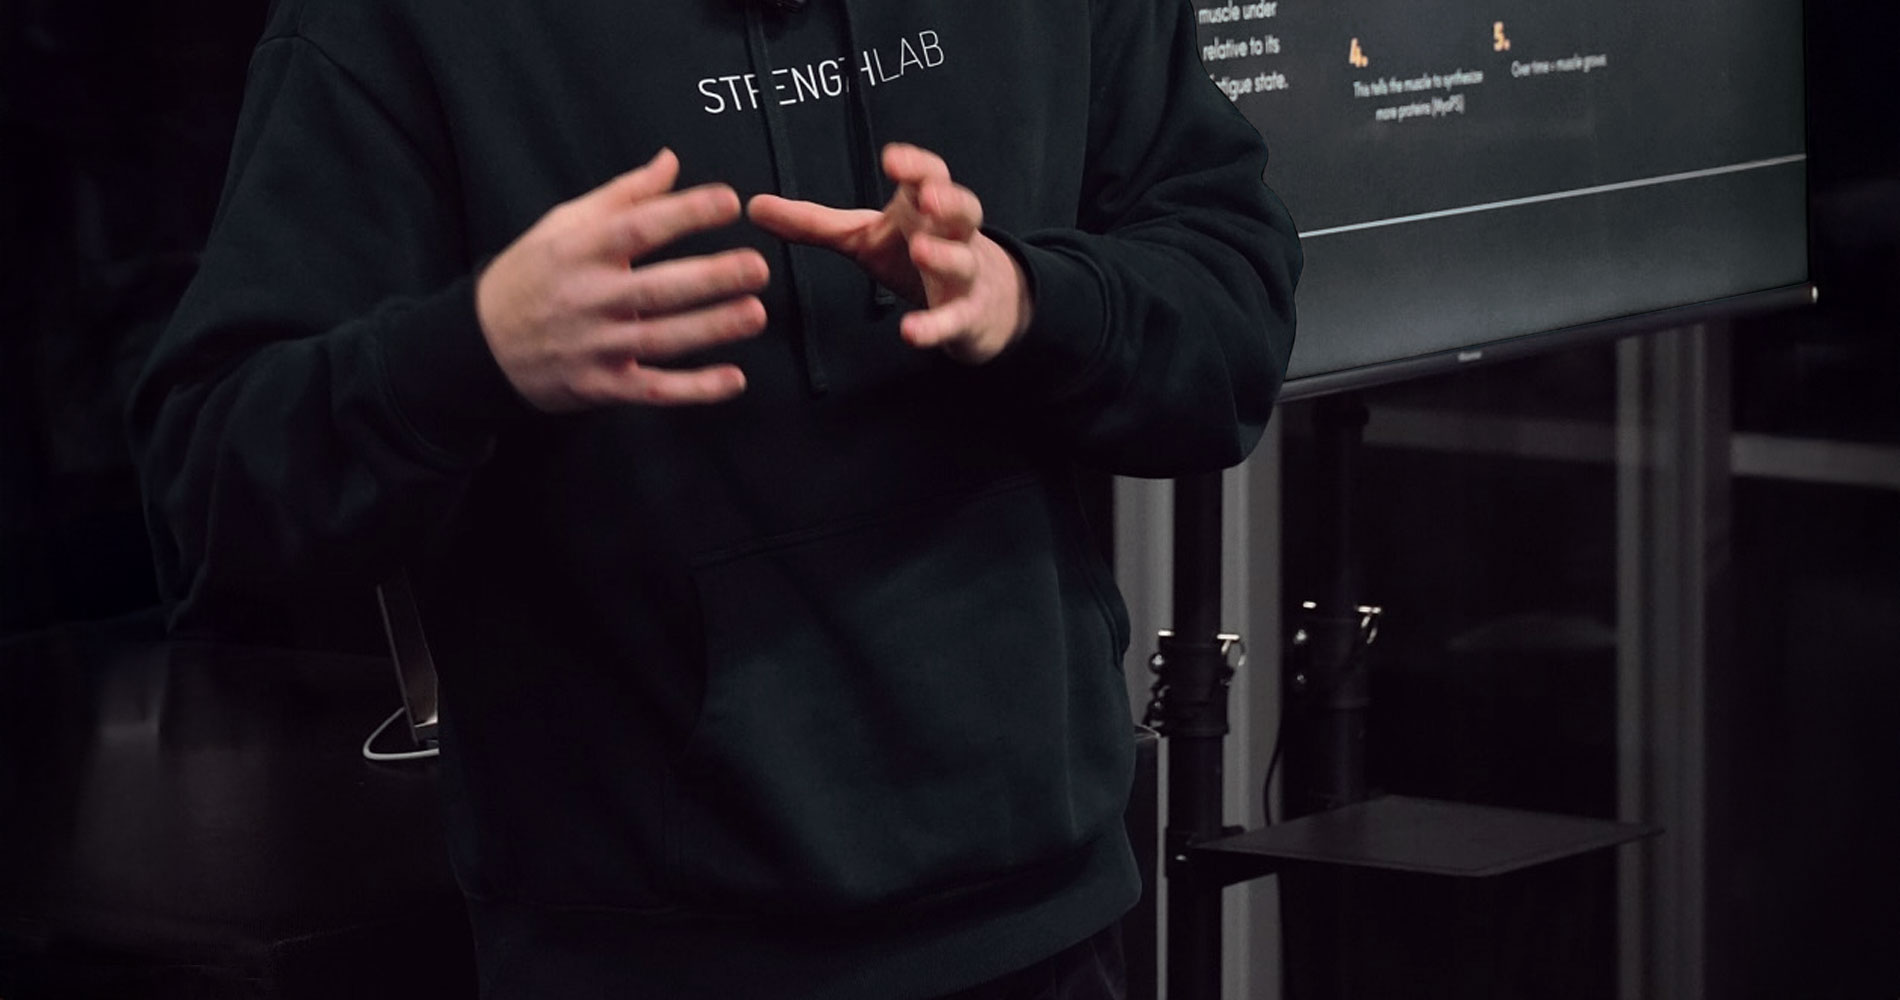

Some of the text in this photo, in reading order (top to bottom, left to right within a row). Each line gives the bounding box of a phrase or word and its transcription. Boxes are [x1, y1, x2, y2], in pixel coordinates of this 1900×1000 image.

[1198, 0, 1240, 24] muscle
[1203, 35, 1280, 61] relative to its
[1494, 22, 1510, 51] 5.
[1349, 38, 1368, 67] 4.
[697, 30, 945, 115] STENGHLAB
[1209, 72, 1288, 102] tigue state.
